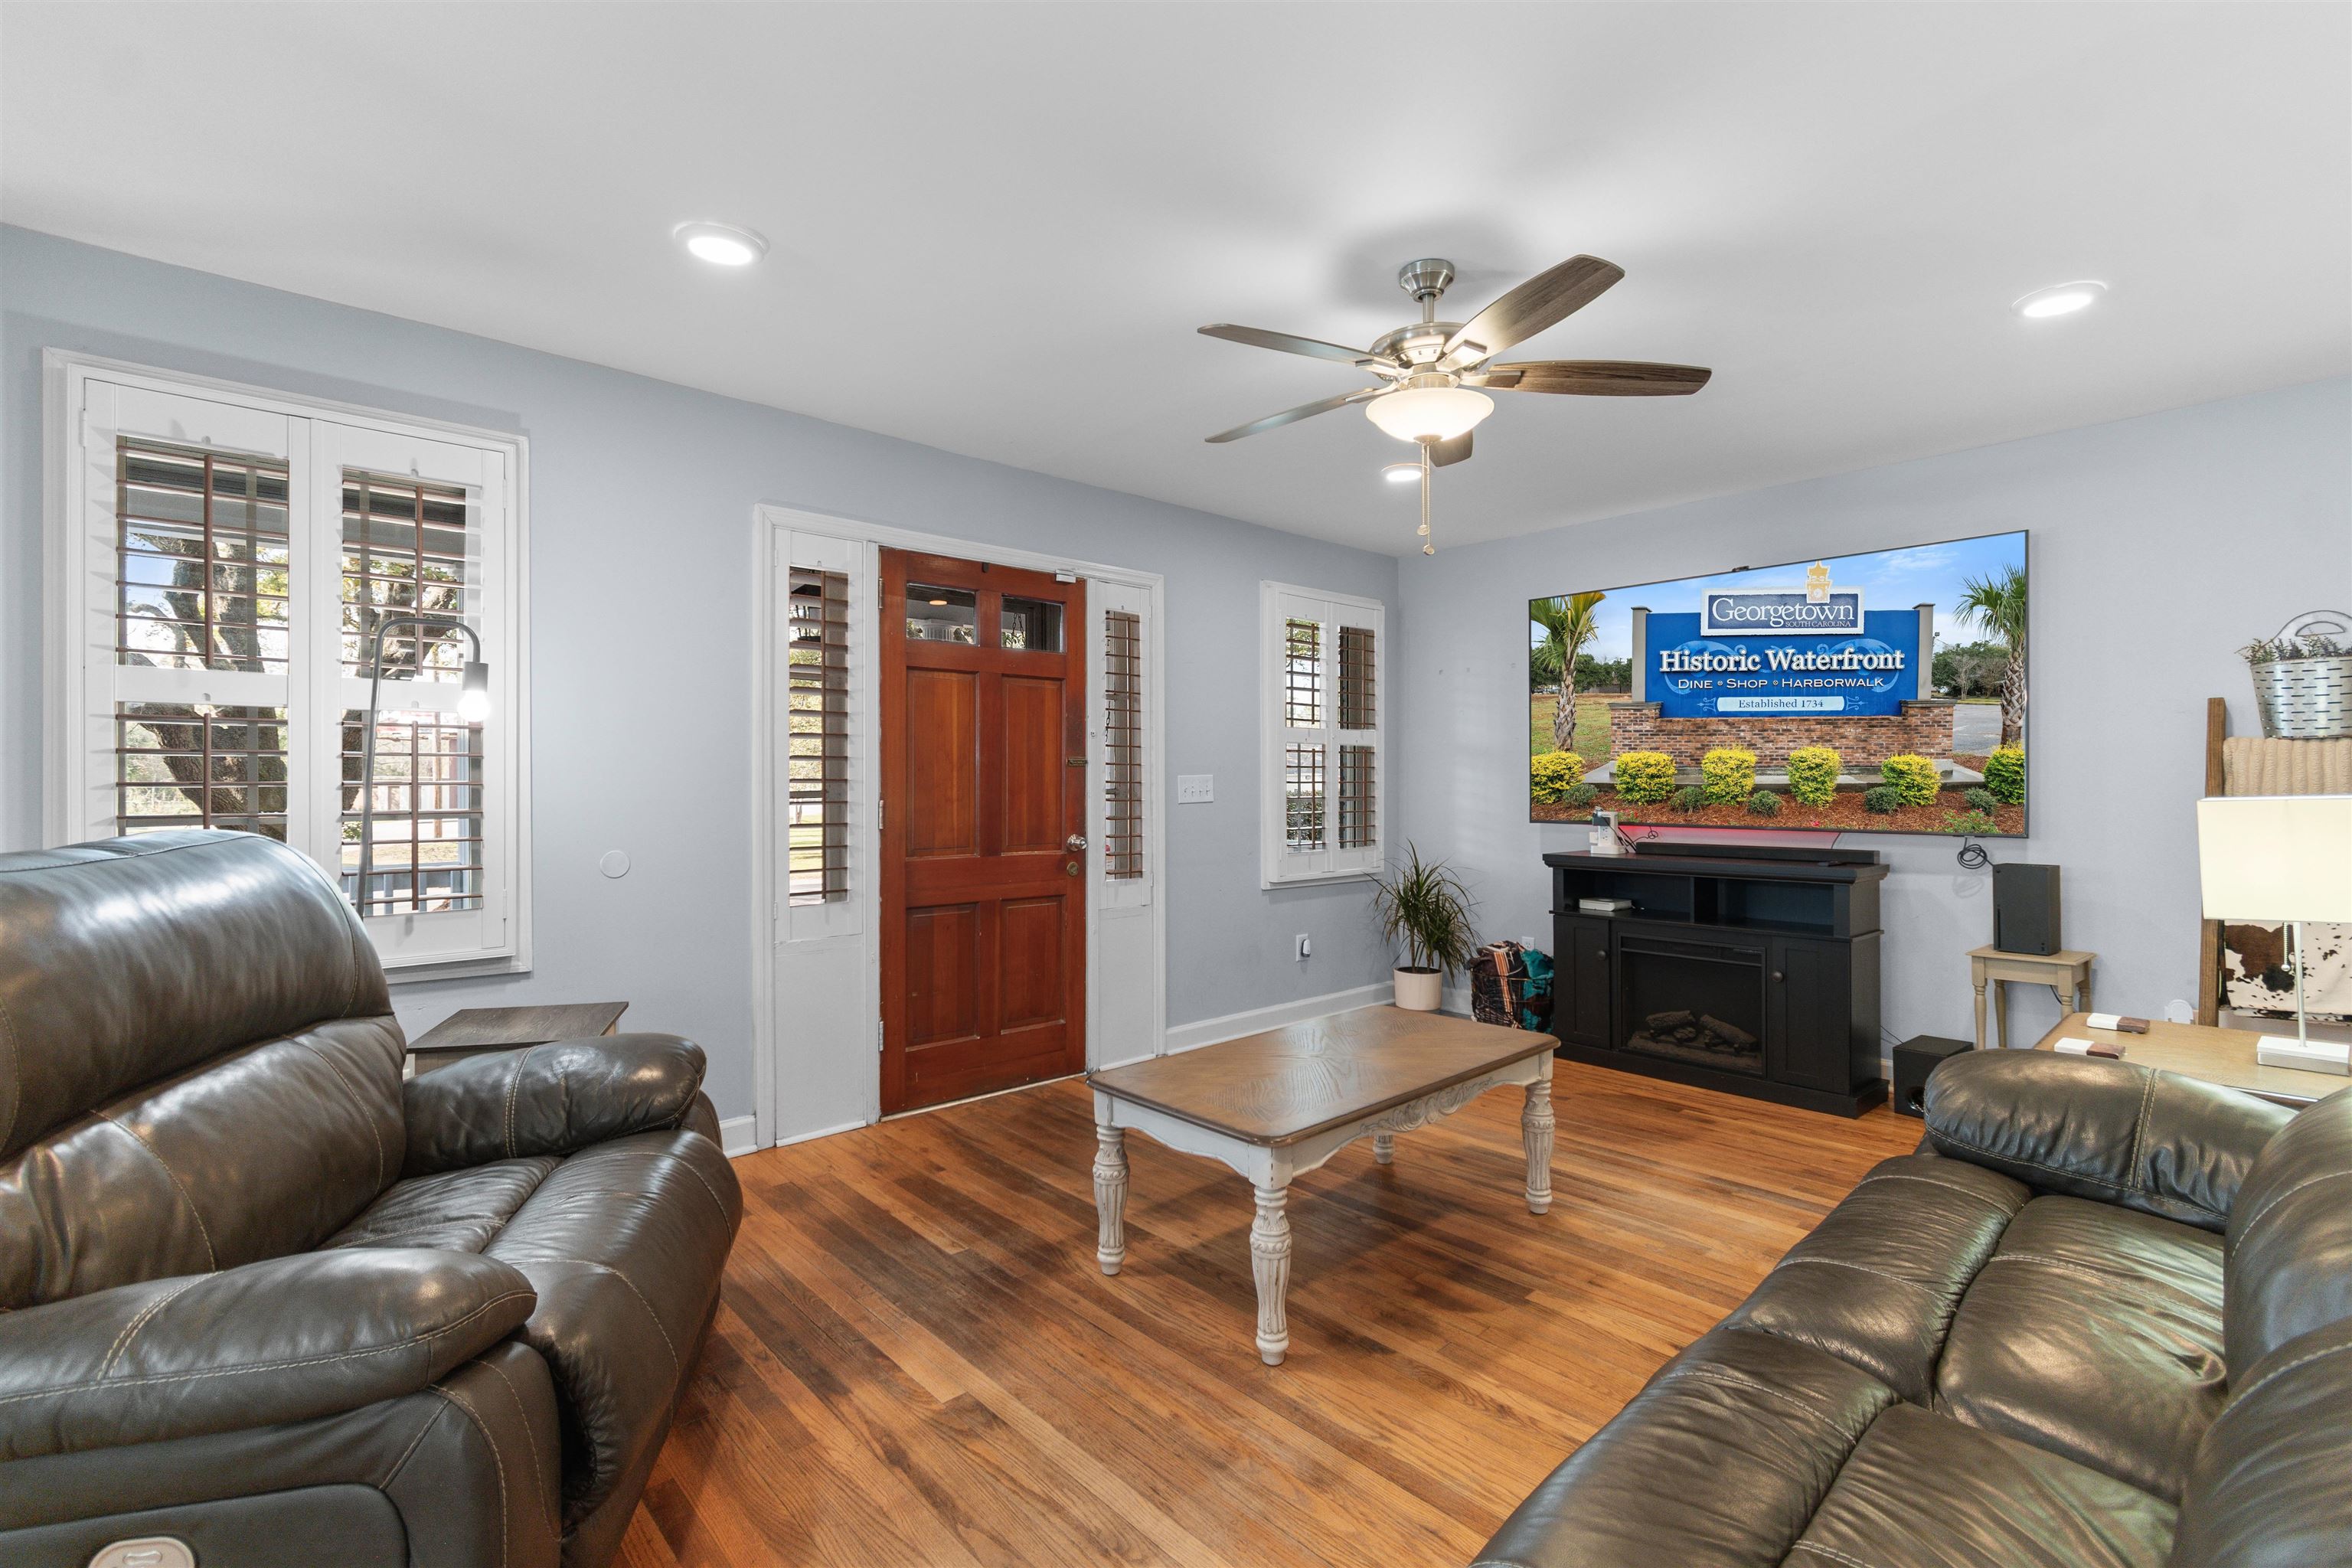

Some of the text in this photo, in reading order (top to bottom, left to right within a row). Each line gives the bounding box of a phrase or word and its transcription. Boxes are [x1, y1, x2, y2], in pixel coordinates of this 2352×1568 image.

[1712, 597, 1855, 628] Georgetown
[1659, 647, 1906, 673] Historic Waterfront
[1678, 678, 1885, 689] DINE SHOP HARBORWALK
[1738, 699, 1824, 708] Established 1734
